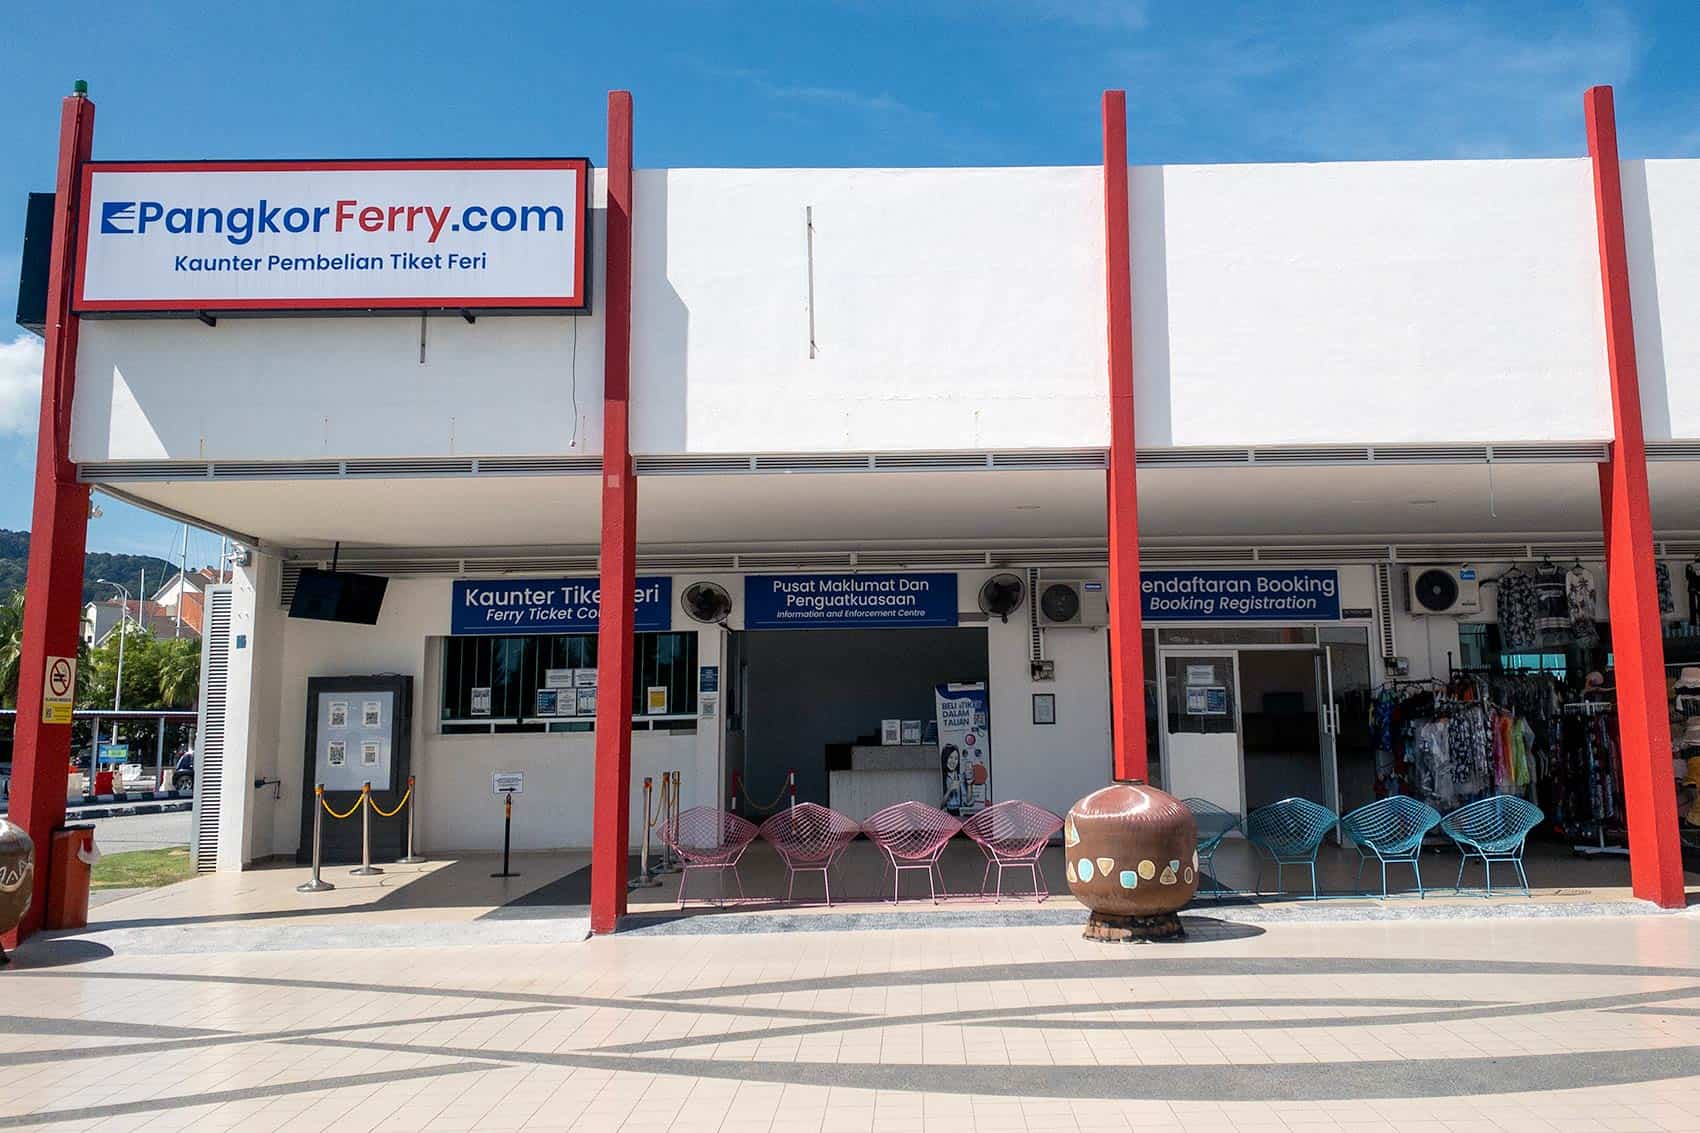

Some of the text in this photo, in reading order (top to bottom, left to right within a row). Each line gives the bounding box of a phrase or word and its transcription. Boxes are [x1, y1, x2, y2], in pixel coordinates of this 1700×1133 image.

[137, 199, 564, 245] PangkorFerry.com
[174, 252, 487, 272] Kaunter Pembelian Tiket Feri
[773, 578, 930, 593] Pusat Maklumat Dan
[1141, 575, 1336, 598] endaftaran Booking
[466, 584, 659, 606] Kaunter Tike eri
[786, 593, 916, 610] Penguatkuasaan
[1150, 595, 1317, 613] Booking Registration
[486, 608, 525, 624] Ferry
[529, 606, 572, 619] Ticket
[777, 608, 926, 618] Information and Enforcement Centre
